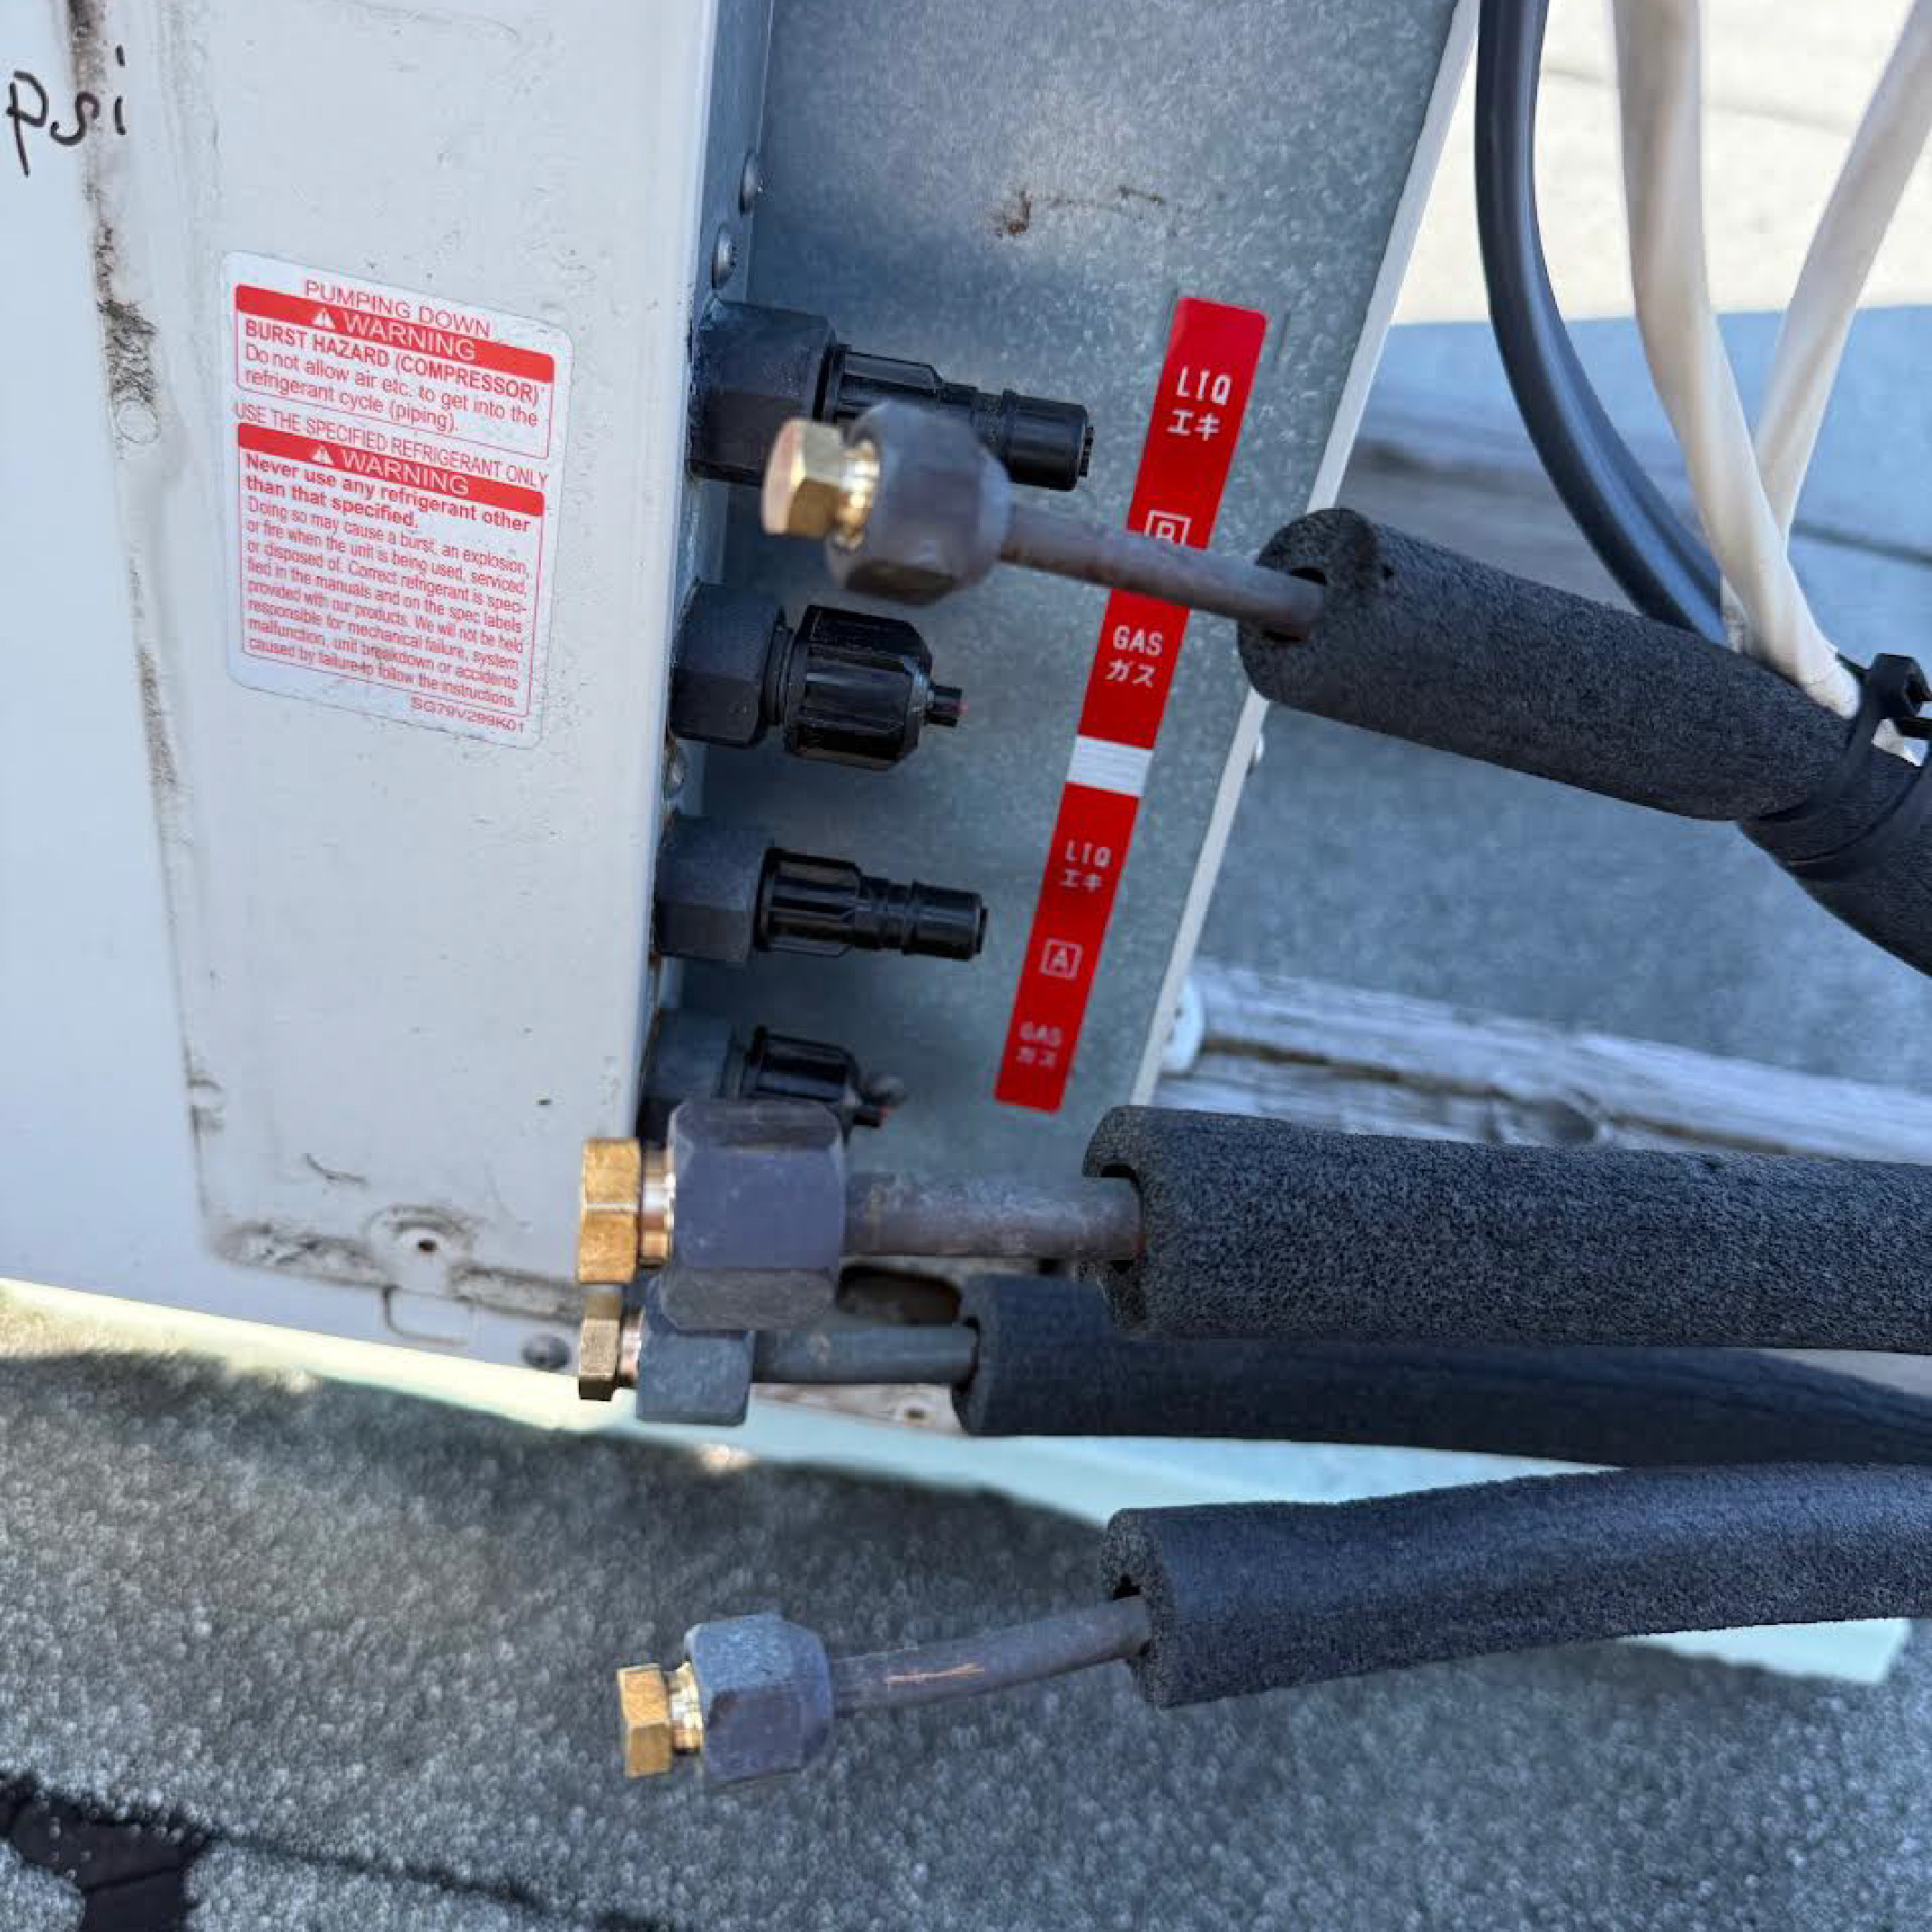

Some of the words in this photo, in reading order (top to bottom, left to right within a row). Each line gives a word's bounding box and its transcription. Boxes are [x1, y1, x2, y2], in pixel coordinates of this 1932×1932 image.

[305, 280, 411, 320] PUMPING
[418, 305, 490, 338] DOWN
[245, 319, 306, 350] BURST
[312, 333, 389, 369] HAZARD
[395, 352, 537, 407] (COMPRESSOR)
[343, 312, 476, 362] WARNING
[245, 342, 268, 364] Do
[274, 353, 300, 371] not
[305, 359, 349, 382] allow
[354, 370, 377, 389] air
[381, 377, 412, 398] etc.
[418, 382, 435, 403] to
[441, 392, 468, 410] get
[473, 396, 505, 419] into
[511, 405, 537, 427] the
[245, 369, 335, 401] refrigerant
[339, 390, 383, 412] cycle
[389, 398, 458, 430] (piping).
[1176, 365, 1232, 406] LIQ
[235, 400, 267, 425] USE
[271, 409, 302, 433] THE
[306, 417, 388, 452] SPECIFIED
[391, 437, 500, 477] REFRIGERANT
[505, 463, 549, 489] ONLY
[1166, 409, 1220, 441] エキ
[245, 451, 300, 479] Never
[304, 469, 336, 487] use
[341, 477, 375, 501] any
[380, 487, 476, 521] refrigerant
[481, 510, 531, 533] other
[245, 473, 285, 497] than
[290, 483, 326, 506] that
[331, 496, 418, 527] specified.
[342, 450, 469, 496] WARNING
[246, 519, 259, 533] or
[264, 519, 284, 538] fire
[289, 527, 322, 547] when
[325, 533, 345, 553] the
[351, 543, 374, 559] unit
[377, 545, 388, 562] is
[390, 549, 428, 574] being
[247, 495, 287, 524] Doing
[291, 509, 307, 524] so
[310, 514, 339, 535] may
[343, 521, 383, 542] cause
[387, 531, 396, 544] a
[442, 544, 458, 559] an
[246, 540, 259, 553] or
[264, 540, 322, 568] disposed
[348, 560, 397, 585] Correct
[400, 575, 469, 601] refrigerant
[472, 588, 484, 605] is
[274, 562, 287, 580] in
[290, 565, 310, 584] the
[314, 575, 372, 599] manuals
[374, 589, 399, 605] and
[402, 595, 419, 610] on
[423, 596, 444, 615] the
[448, 606, 479, 623] spec
[484, 610, 523, 633] labels
[246, 579, 301, 602] provided
[303, 590, 327, 608] with
[332, 599, 351, 614] our
[415, 614, 434, 633] We
[437, 620, 456, 638] will
[459, 627, 477, 643] not
[480, 629, 495, 647] be
[247, 599, 322, 626] responsible
[326, 613, 345, 631] for
[348, 621, 421, 649] mechanical
[472, 650, 518, 670] system
[248, 638, 295, 658] caused
[300, 646, 314, 666] by
[418, 672, 437, 690] the
[332, 638, 357, 653] unit
[360, 640, 434, 671] breakdown
[437, 662, 452, 675] or
[454, 666, 517, 690] accidents
[1112, 624, 1163, 657] GAS
[1105, 659, 1156, 687] ガス
[1060, 868, 1103, 893] エキ
[1065, 839, 1112, 869] LIQ
[1051, 947, 1069, 970] A
